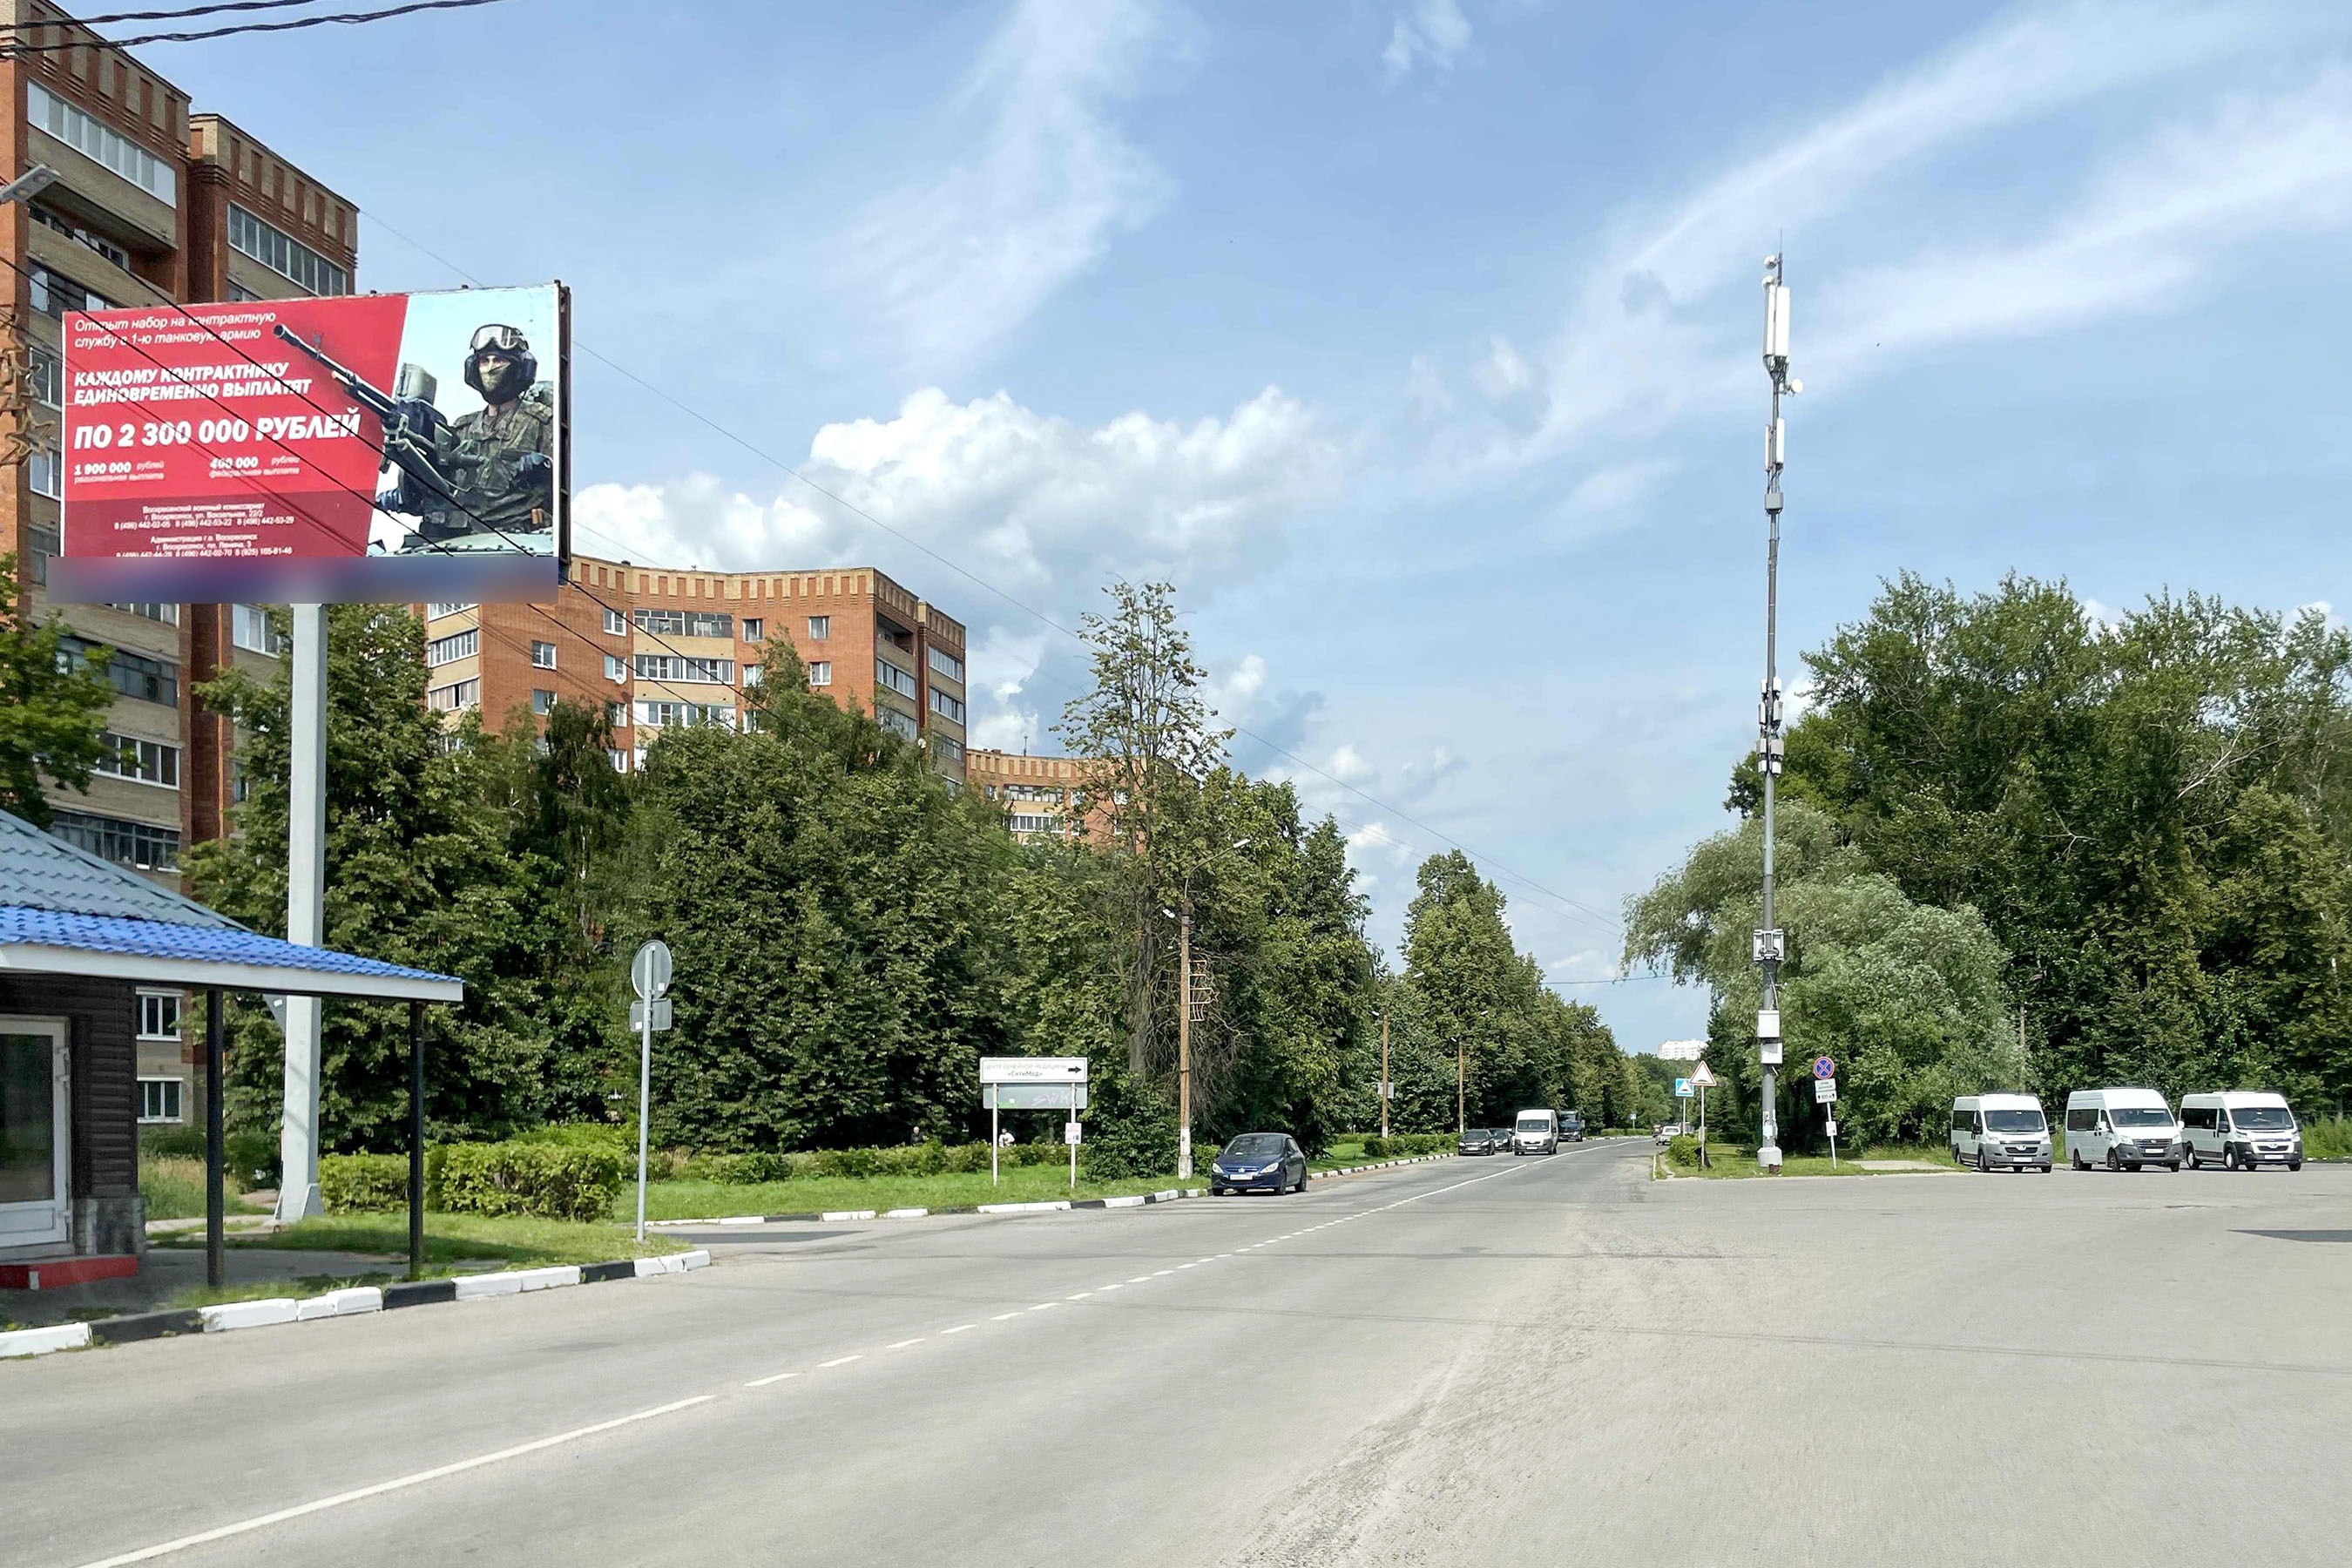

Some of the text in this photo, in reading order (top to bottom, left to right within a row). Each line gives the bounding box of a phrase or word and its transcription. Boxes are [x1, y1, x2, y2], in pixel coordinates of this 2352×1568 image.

[75, 312, 276, 333] Открыт набор на контрактную
[75, 334, 118, 349] службу
[132, 333, 152, 345] 1-ю
[220, 329, 261, 342] армию
[74, 362, 289, 388] КАЖДОМУ КОНТРАКТНИКУ
[74, 378, 312, 405] ЕДИНОВРЕМЕННО ВЫПЛАТЯТ
[74, 407, 362, 449] ПО 2 300 000 РУБЛЕЙ
[74, 464, 82, 476] 1
[84, 463, 107, 475] 900
[109, 461, 132, 474] 000
[210, 457, 233, 470] 400
[235, 456, 259, 469] 000
